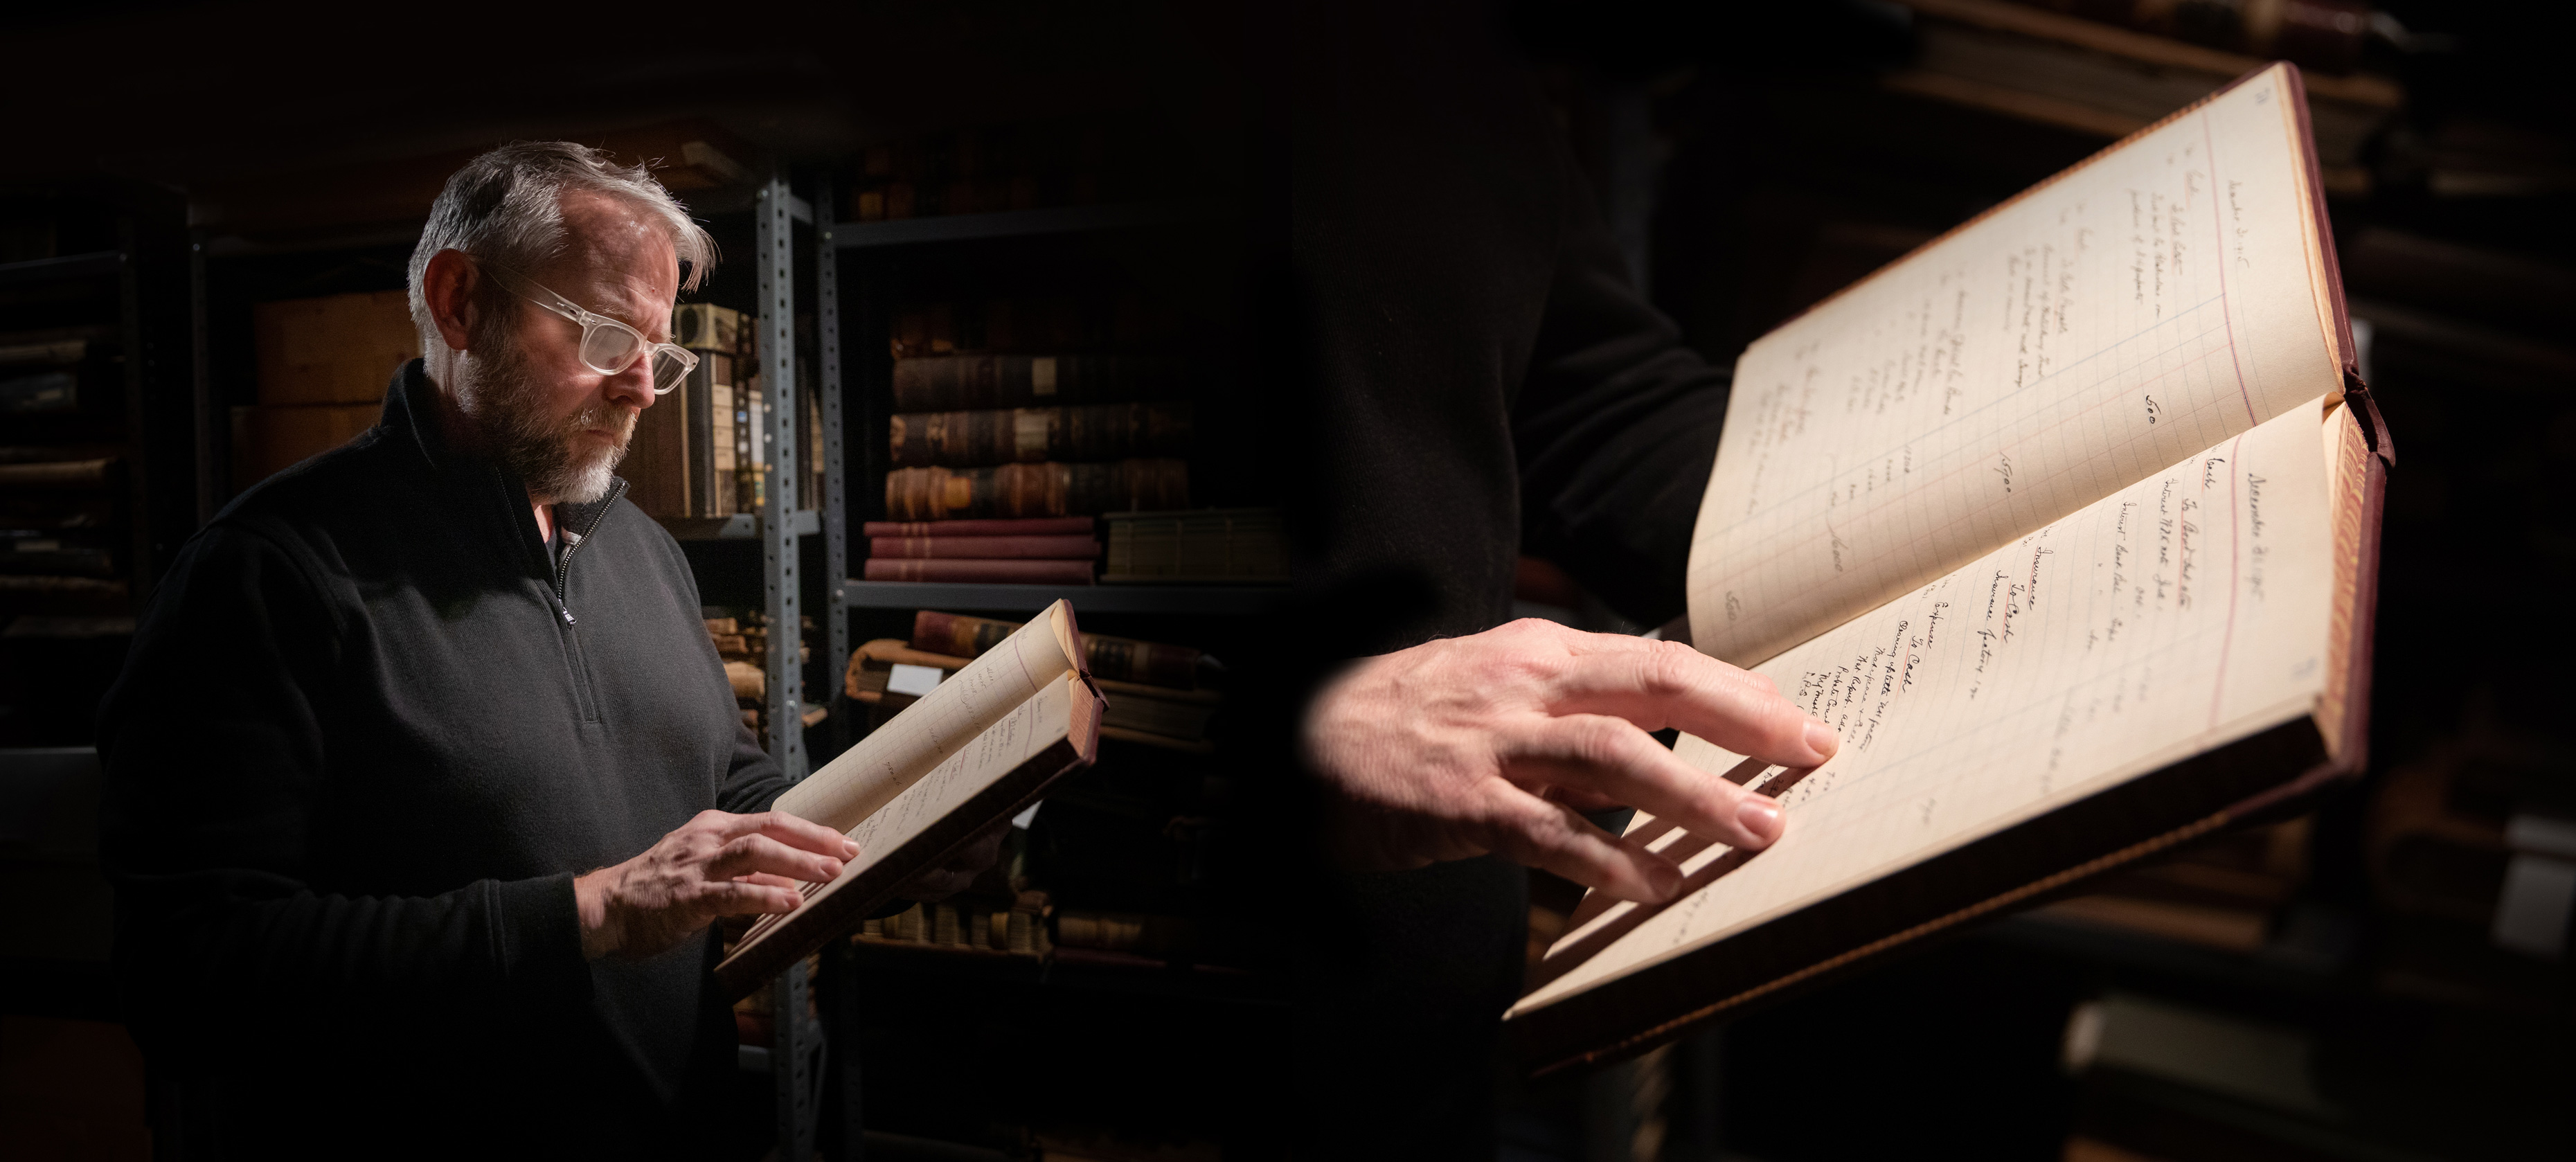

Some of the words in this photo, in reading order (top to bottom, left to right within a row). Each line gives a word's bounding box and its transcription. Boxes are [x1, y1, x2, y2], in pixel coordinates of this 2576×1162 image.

[2145, 395, 2161, 424] 500
[2160, 478, 2176, 515] Interest
[2181, 498, 2198, 512] To
[2116, 500, 2137, 539] Interest
[1987, 570, 2009, 619] Insurance
[2009, 584, 2025, 598] To
[2028, 546, 2054, 611] Insurance
[1886, 620, 1908, 658] Clearing
[1920, 602, 1949, 650] Expense
[2003, 596, 2019, 643] Cash
[1911, 635, 1924, 649] To
[1976, 628, 1997, 673] factory
[1902, 654, 1920, 693] Cash
